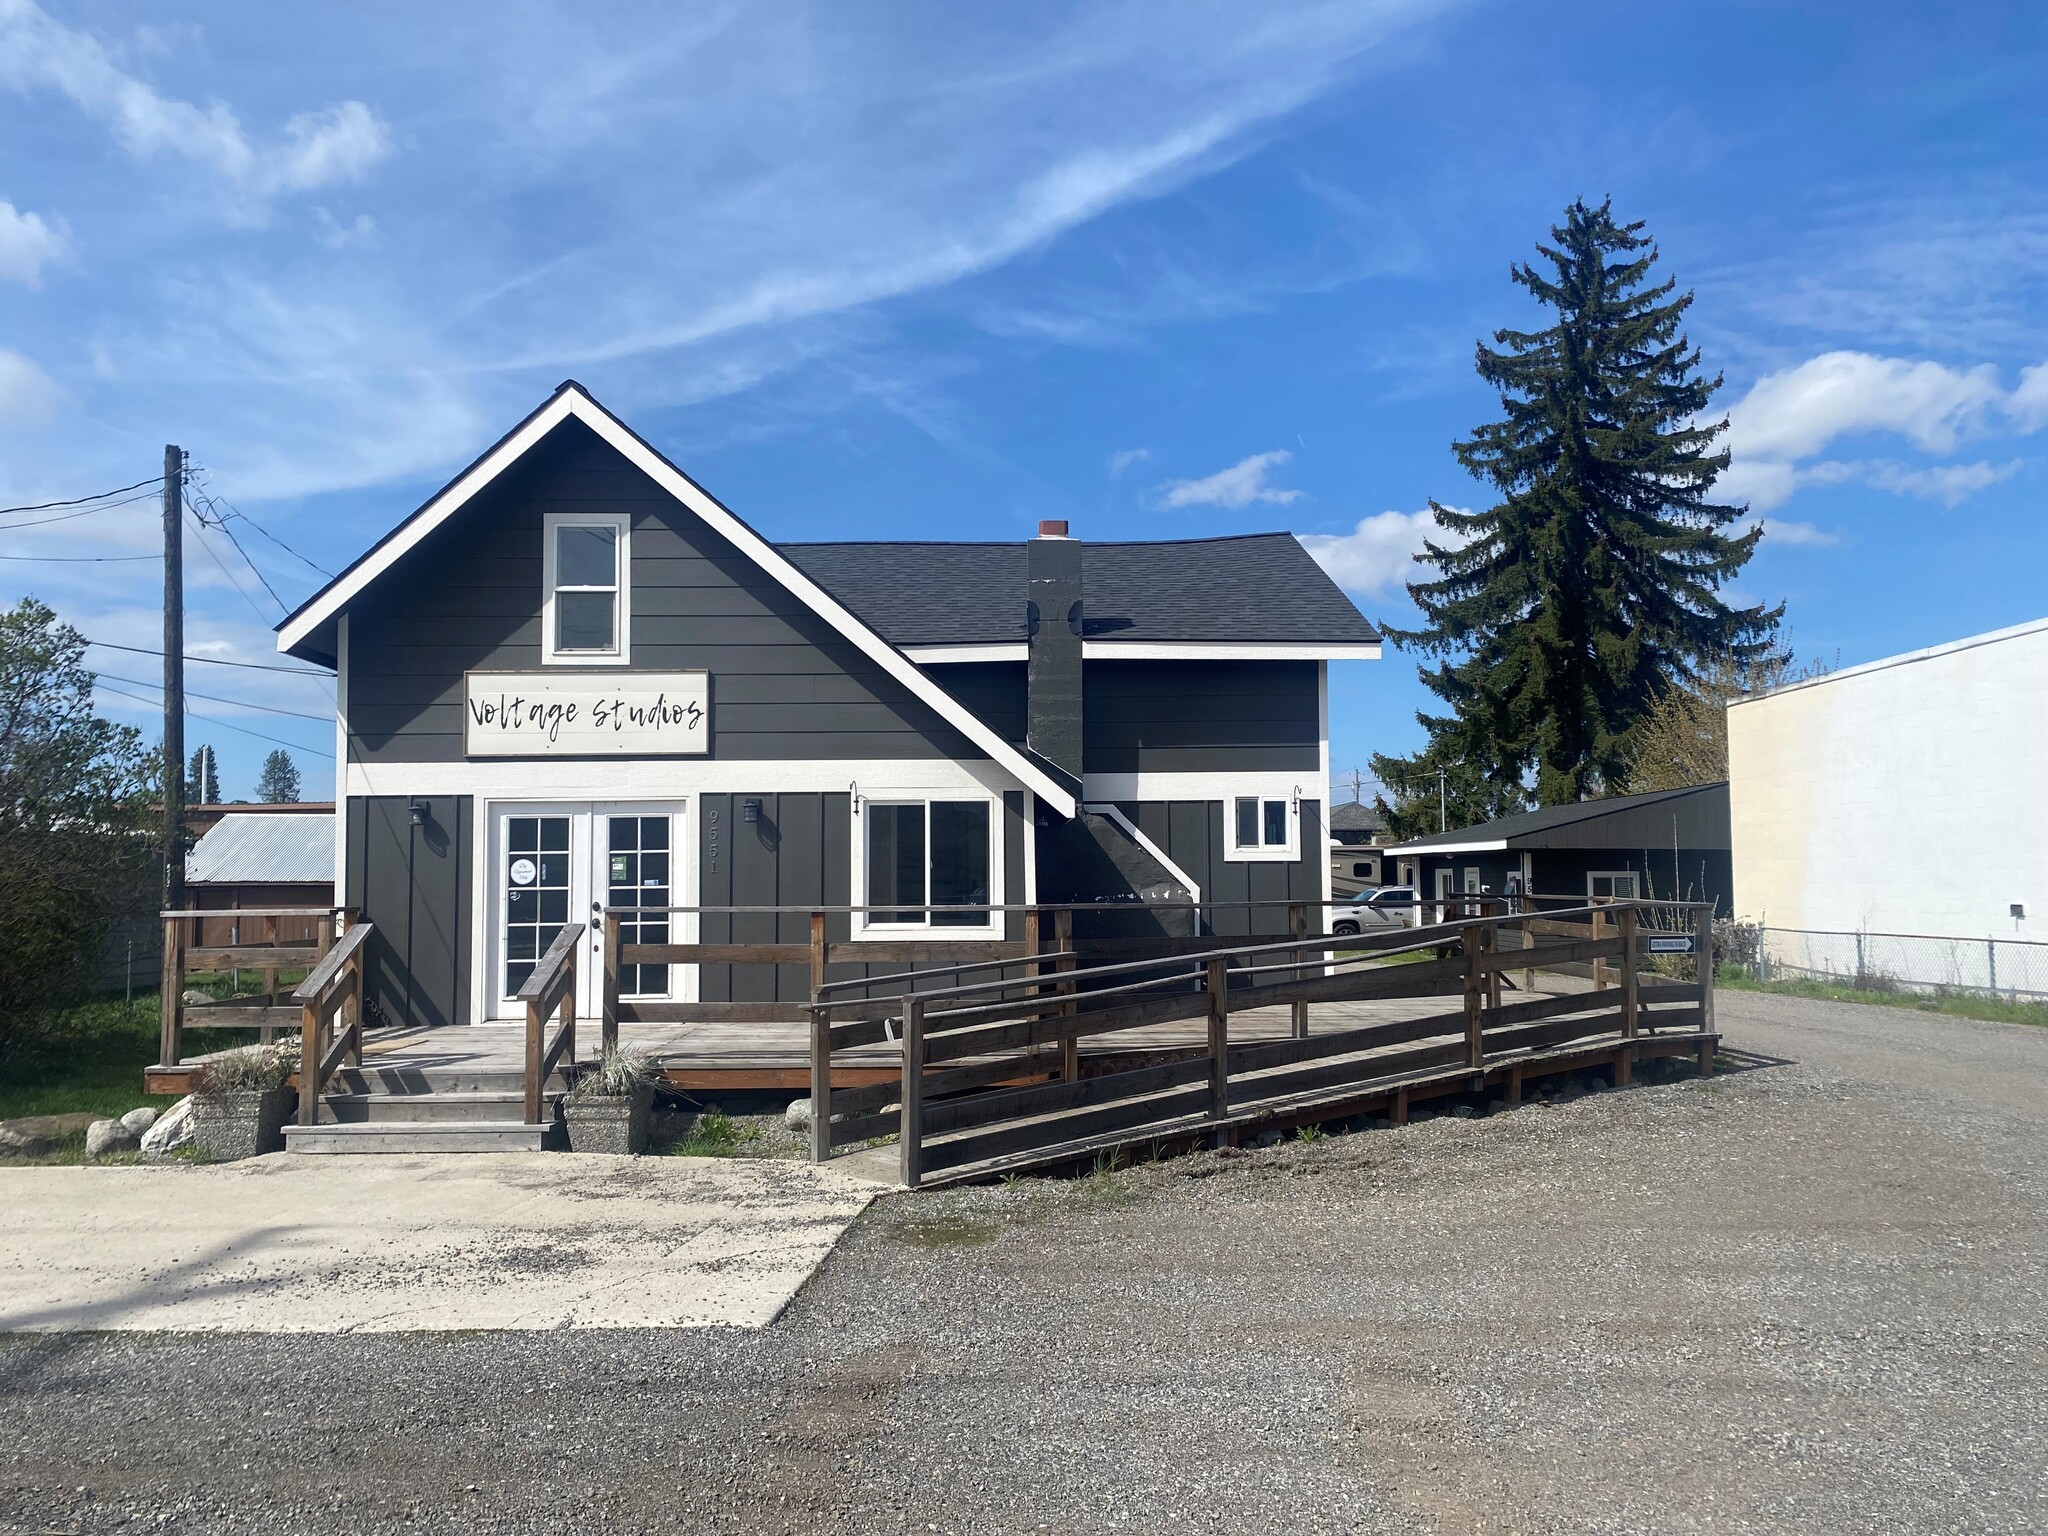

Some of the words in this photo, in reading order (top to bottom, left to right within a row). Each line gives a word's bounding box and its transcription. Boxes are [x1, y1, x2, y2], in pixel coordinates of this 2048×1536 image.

[470, 694, 579, 742] Voltage
[592, 693, 705, 731] studios
[710, 810, 719, 875] 9551
